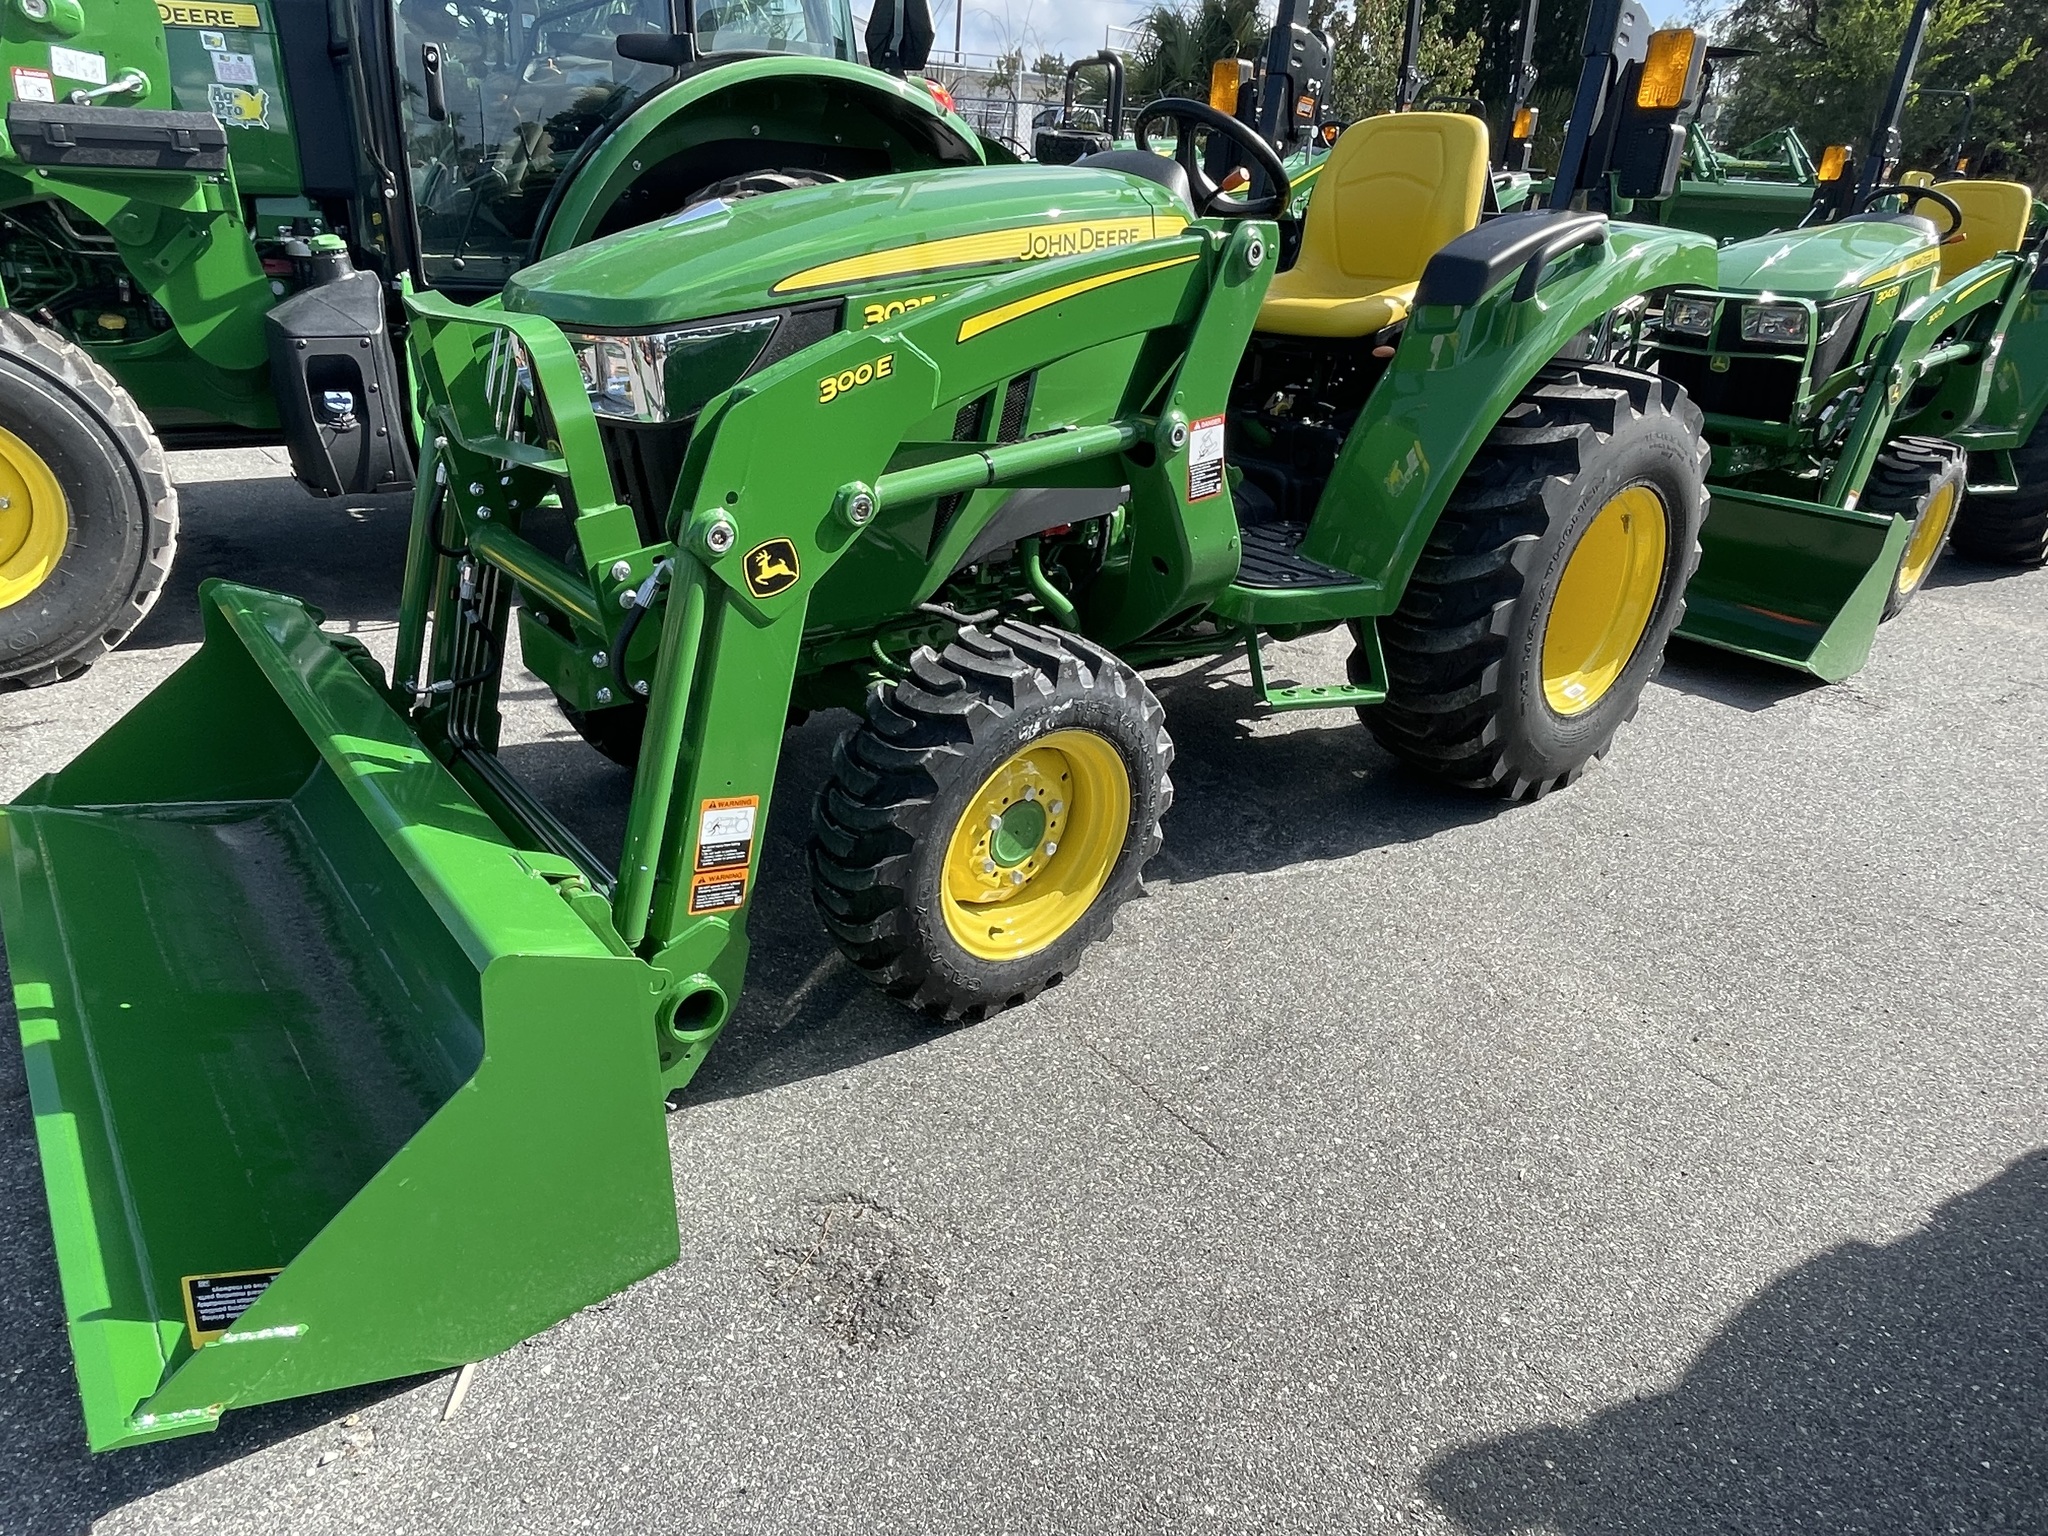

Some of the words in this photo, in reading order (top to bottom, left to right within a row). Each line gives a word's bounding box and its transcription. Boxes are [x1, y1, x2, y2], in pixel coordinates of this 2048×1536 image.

[215, 102, 243, 116] Pro
[1020, 233, 1077, 256] JOHN
[1080, 228, 1140, 249] DEERE
[717, 799, 752, 808] WARNING
[708, 872, 743, 882] WARNING
